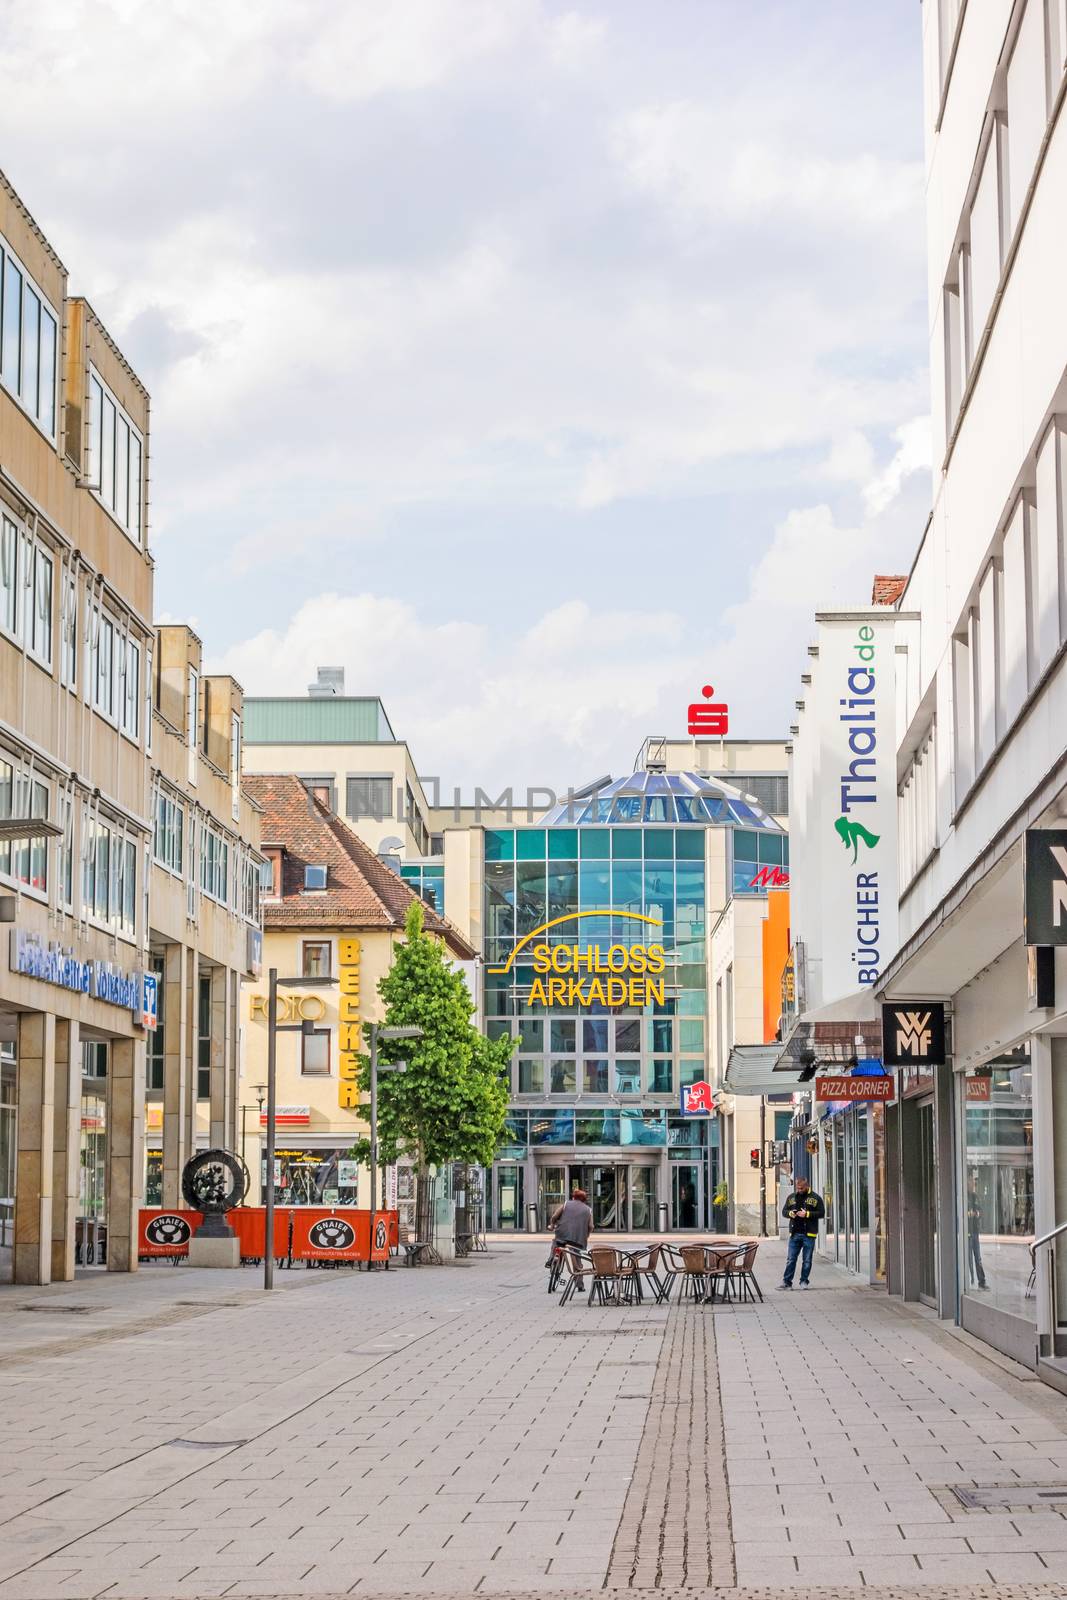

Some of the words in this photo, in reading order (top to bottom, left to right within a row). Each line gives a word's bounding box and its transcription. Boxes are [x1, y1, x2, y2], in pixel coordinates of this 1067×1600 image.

[839, 625, 877, 813] Thalia.de
[851, 871, 881, 984] BÜCHER
[533, 944, 666, 974] SCHLOSS
[250, 993, 326, 1021] FOTO
[527, 977, 665, 1007] ARKADEN
[338, 938, 361, 1108] BECKER
[895, 1011, 932, 1056] WMF
[820, 1082, 847, 1097] PIZZA
[850, 1081, 890, 1097] CORNER
[152, 1218, 185, 1229] GNAIER
[316, 1221, 349, 1233] GNAIER
